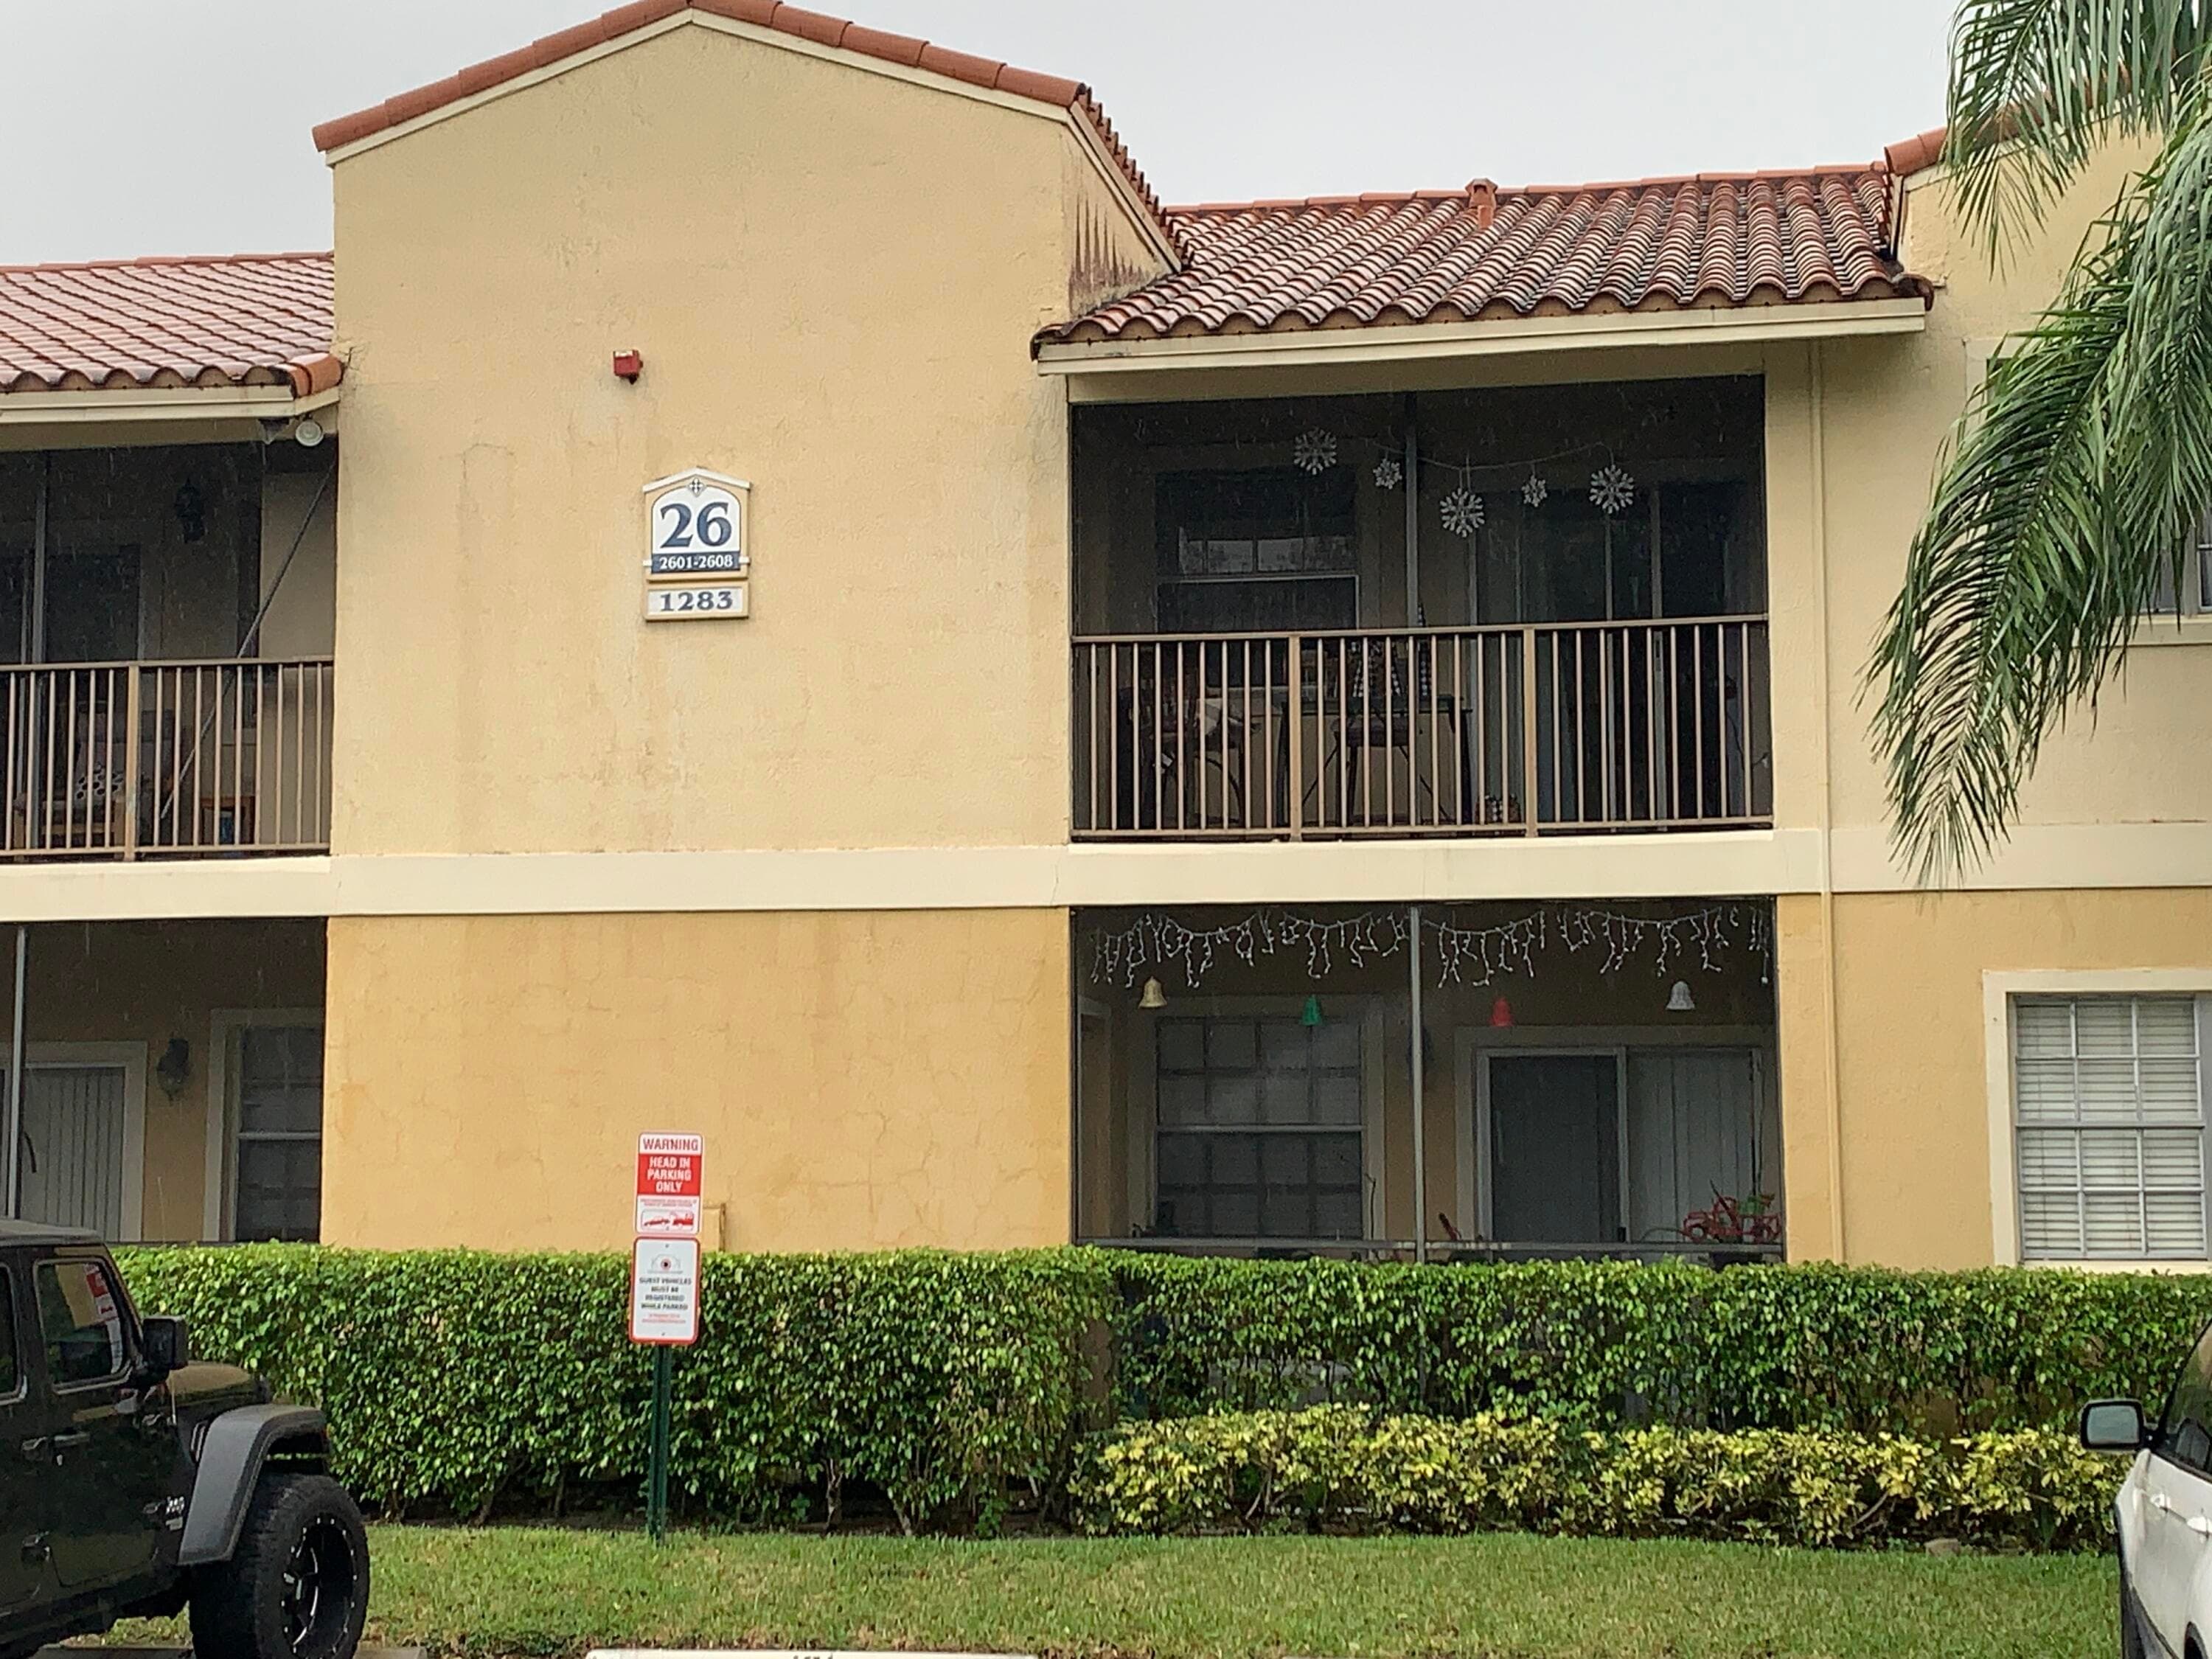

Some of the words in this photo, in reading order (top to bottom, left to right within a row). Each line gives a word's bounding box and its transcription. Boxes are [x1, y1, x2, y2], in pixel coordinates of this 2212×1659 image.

[660, 501, 732, 549] 26
[659, 554, 733, 570] 2601-2608
[660, 591, 733, 611] 1283
[643, 1138, 698, 1151] WARNING
[649, 1156, 677, 1168] HEAD
[679, 1157, 691, 1167] IN
[647, 1169, 692, 1181] PARKING
[655, 1181, 683, 1192] ONLY
